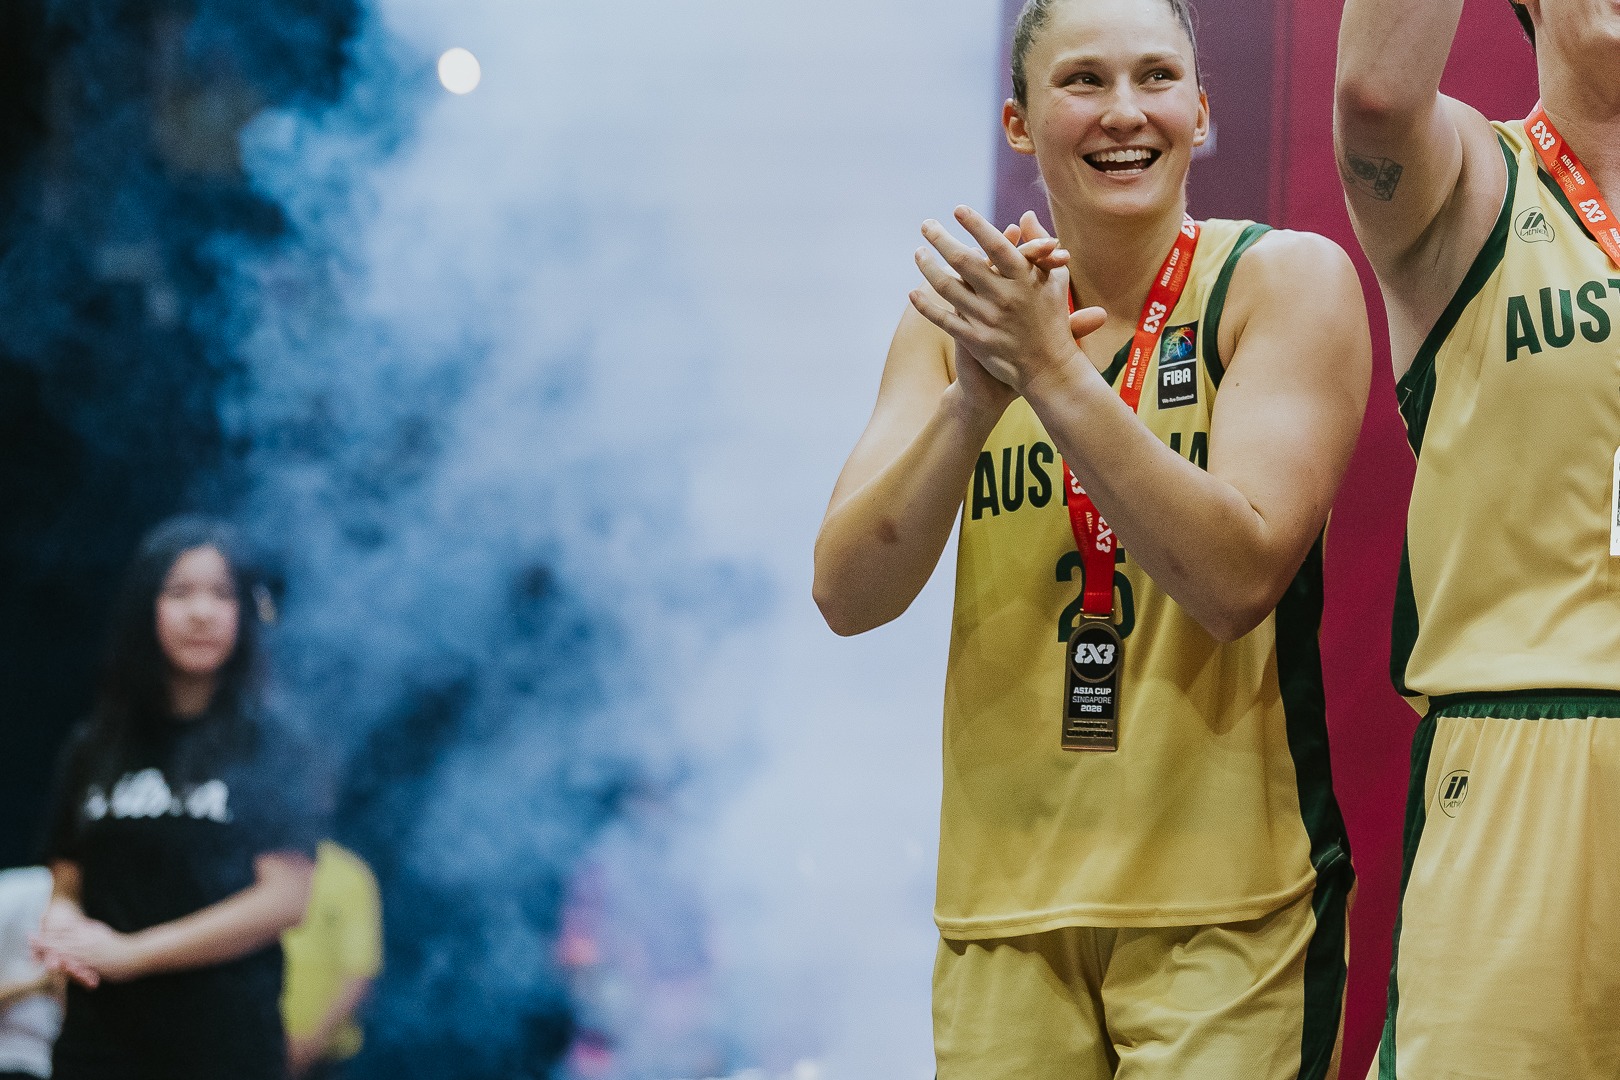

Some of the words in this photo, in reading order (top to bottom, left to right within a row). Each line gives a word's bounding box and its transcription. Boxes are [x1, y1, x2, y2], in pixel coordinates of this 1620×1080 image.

[1560, 154, 1577, 174] ASIA
[1572, 171, 1586, 186] CUP
[1160, 267, 1174, 287] ASIA
[1169, 247, 1180, 266] CUP
[1126, 367, 1136, 388] ASIA
[1132, 347, 1141, 366] CUP
[1163, 368, 1191, 387] FIBA
[1072, 696, 1112, 704] SINGAPORE
[1074, 687, 1094, 695] ASIA
[1095, 687, 1112, 695] CUP
[1081, 704, 1102, 713] 2026
